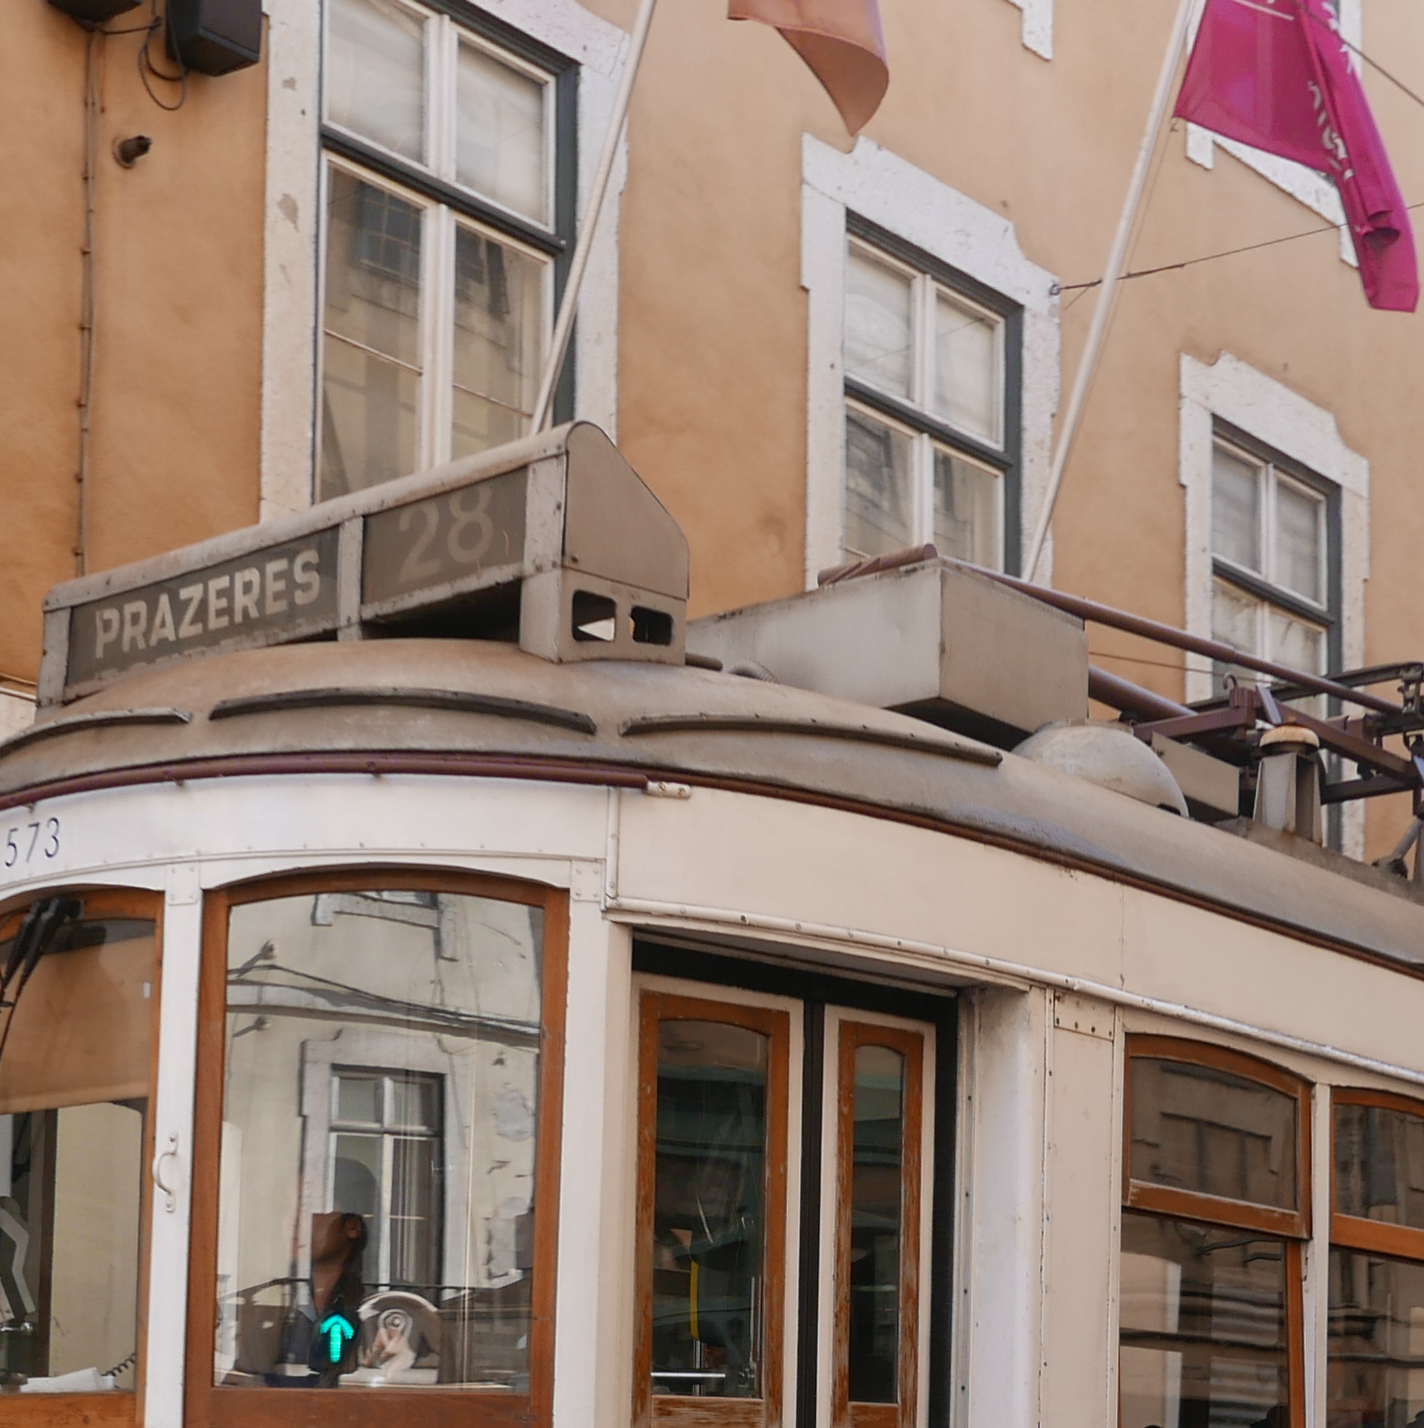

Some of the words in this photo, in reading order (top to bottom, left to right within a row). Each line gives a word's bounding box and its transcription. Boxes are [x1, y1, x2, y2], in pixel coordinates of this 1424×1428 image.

[95, 549, 321, 659] PRAZERES
[399, 484, 494, 582] 28
[5, 817, 60, 867] 573
